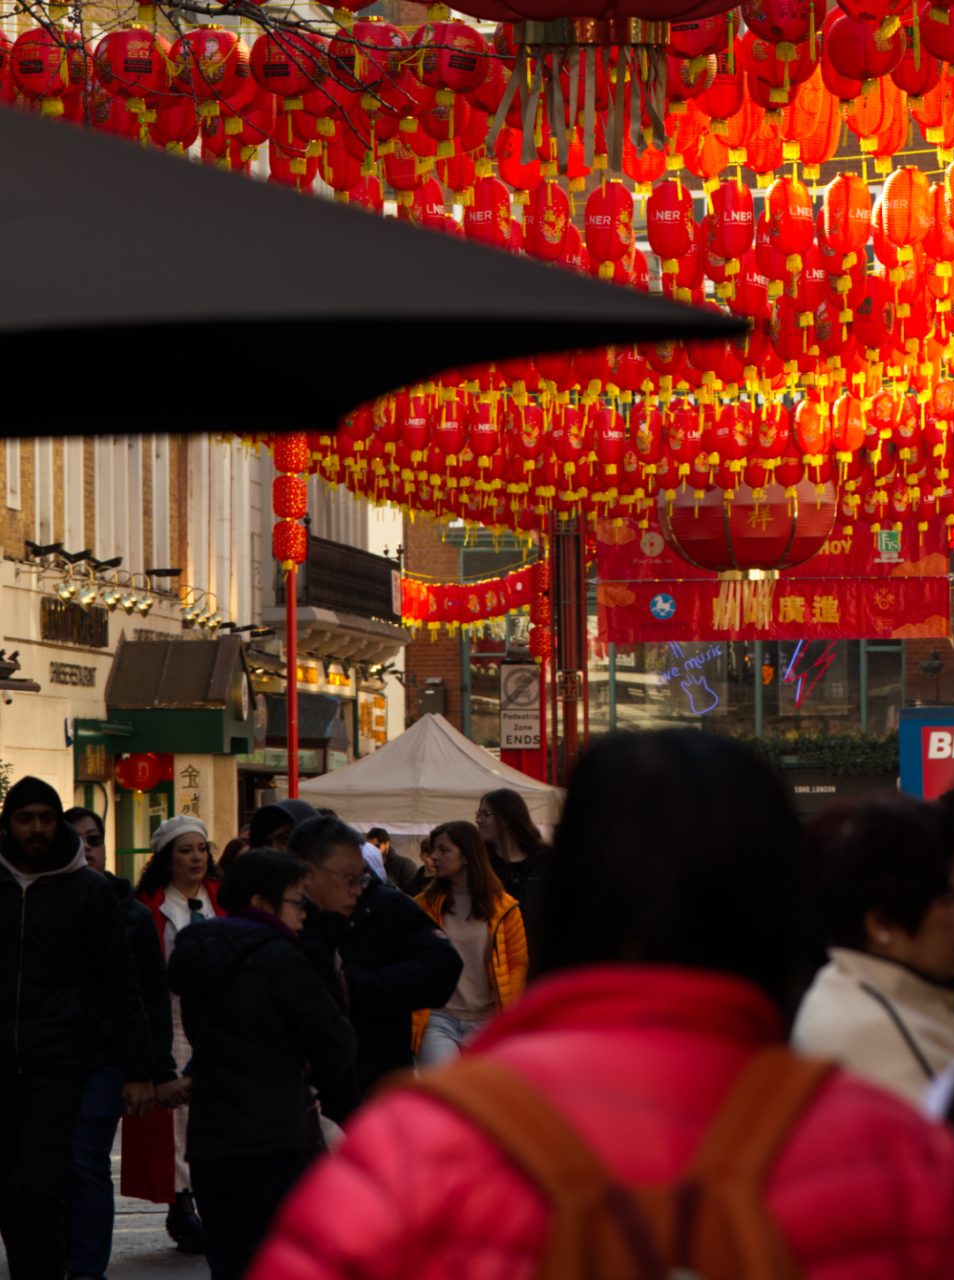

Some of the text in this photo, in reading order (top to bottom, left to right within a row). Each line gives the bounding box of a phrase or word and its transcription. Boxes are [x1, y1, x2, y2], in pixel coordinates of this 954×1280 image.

[426, 203, 445, 215] LNE
[848, 208, 871, 220] LNE
[723, 209, 753, 222] LNER
[805, 268, 825, 280] LNE
[502, 712, 540, 721] Pedestria
[513, 723, 533, 732] Zone
[505, 734, 541, 745] ENDS
